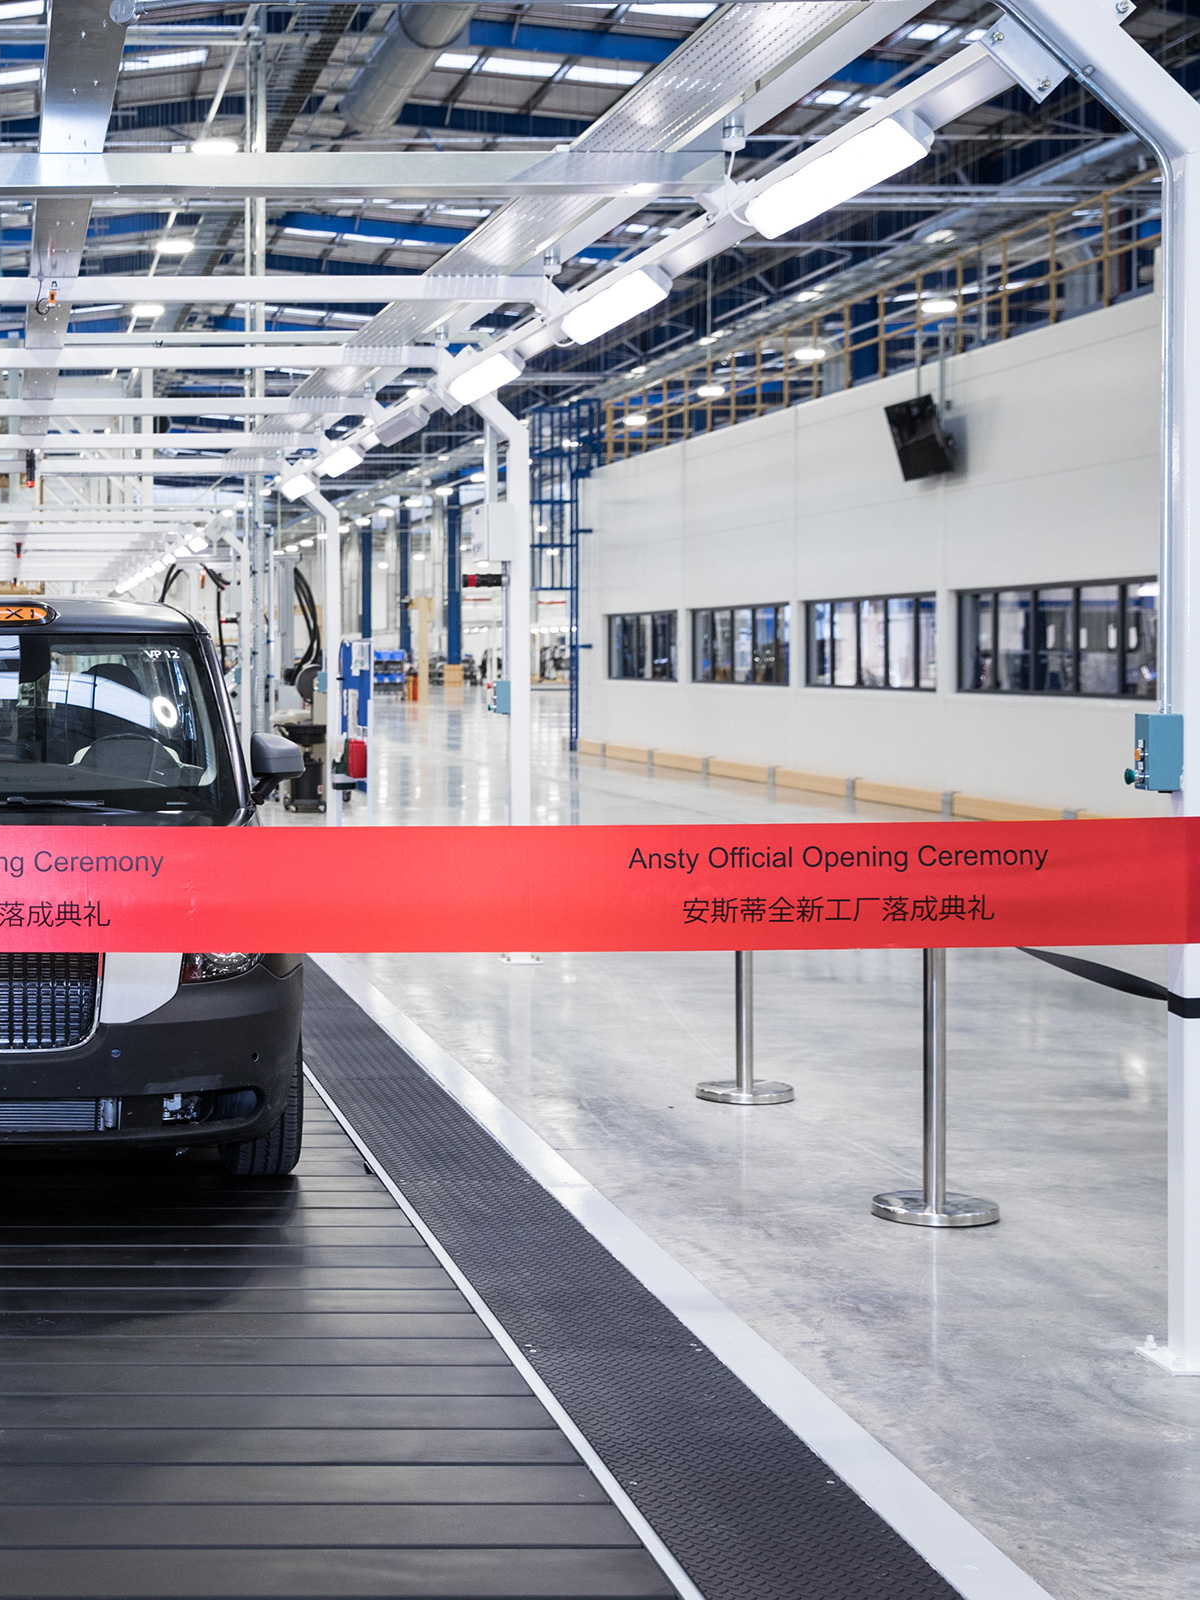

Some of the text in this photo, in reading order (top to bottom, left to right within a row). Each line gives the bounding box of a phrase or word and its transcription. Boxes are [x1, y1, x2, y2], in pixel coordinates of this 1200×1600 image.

[144, 649, 180, 659] VP 12
[34, 851, 163, 877] Ceremony
[628, 845, 1048, 874] Ansty Official Opening Ceremony
[683, 895, 994, 924] 安斯蒂全新工厂落成典礼
